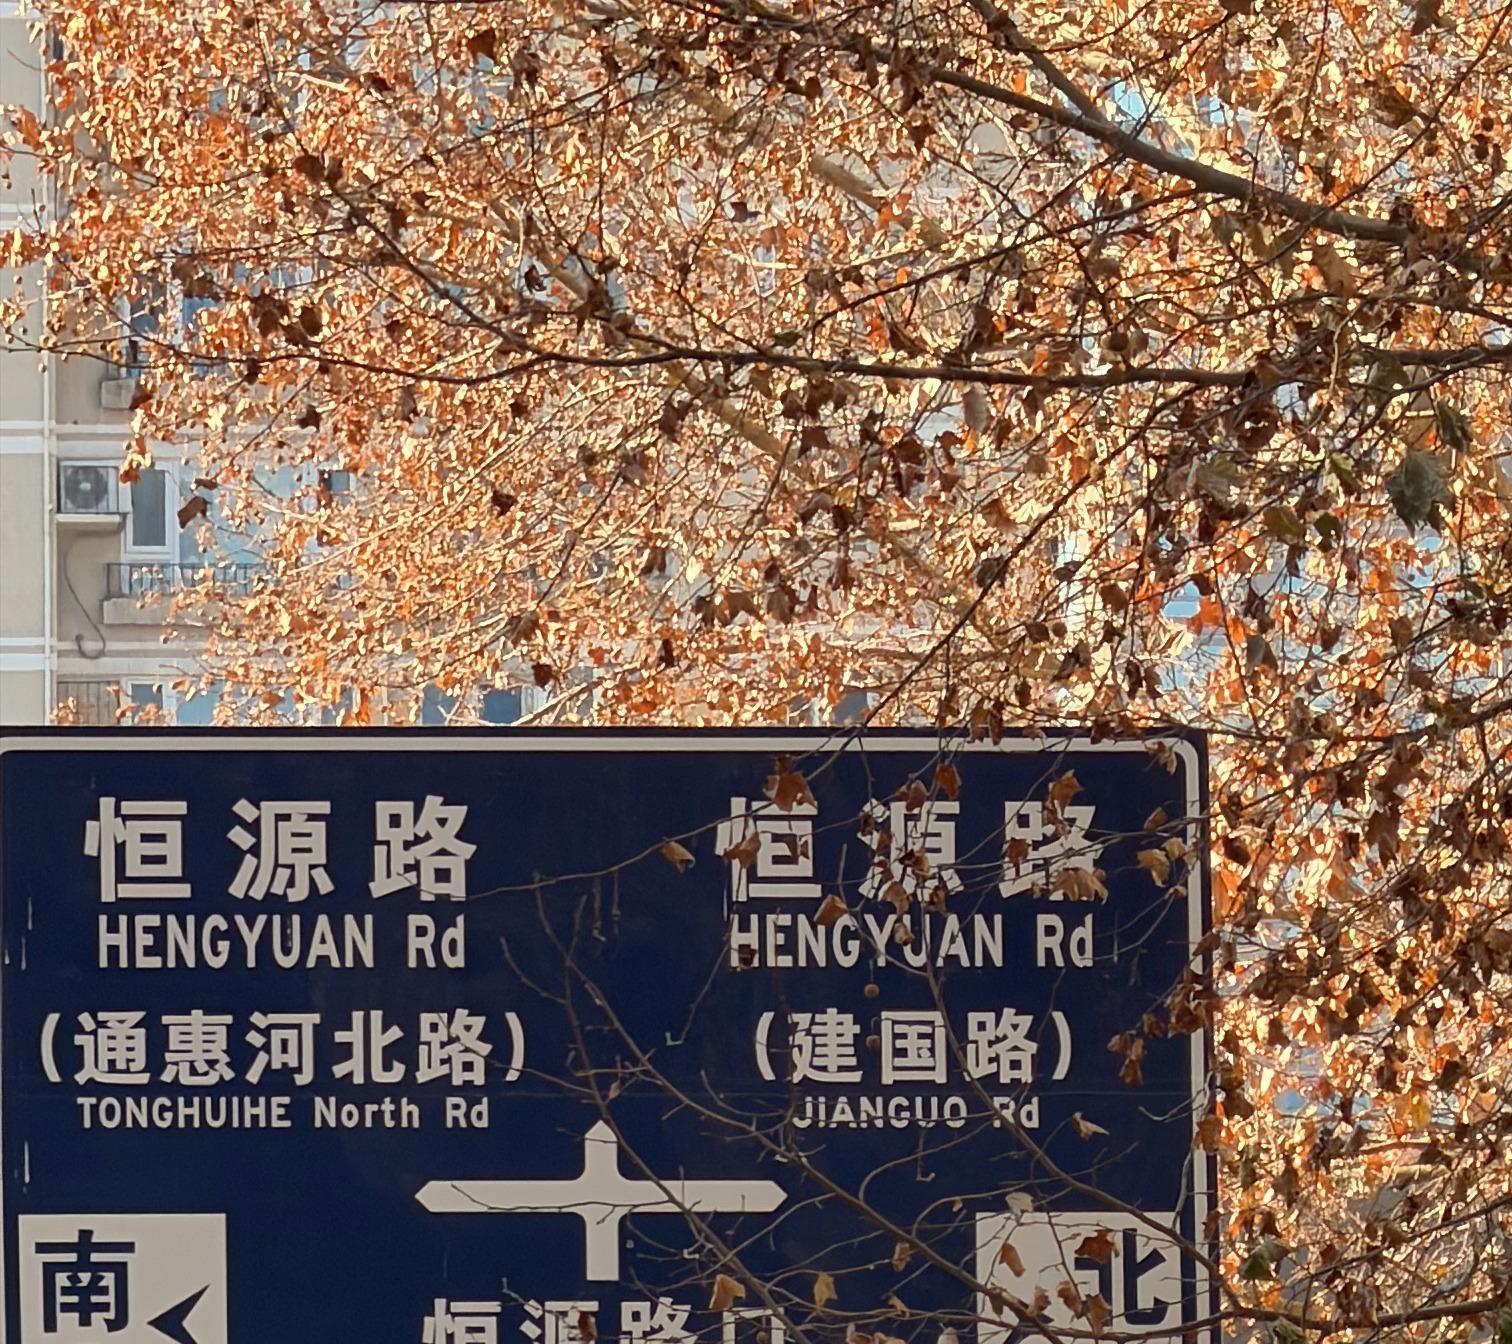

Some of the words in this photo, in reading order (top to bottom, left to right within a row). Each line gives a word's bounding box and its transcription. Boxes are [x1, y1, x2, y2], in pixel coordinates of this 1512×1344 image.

[84, 795, 476, 902] 恒源路
[715, 797, 1108, 902] 恒源路
[99, 914, 375, 969] HENGYUAN
[407, 914, 465, 969] Rd
[729, 914, 1003, 969] HENGYUAN
[1036, 913, 1094, 969] Rd
[40, 1008, 525, 1086] (通惠河北路)
[755, 1007, 1072, 1085] (建国路)
[76, 1096, 292, 1129] TONGHUIHE
[314, 1096, 420, 1129] North
[446, 1096, 489, 1129] Rd
[792, 1096, 968, 1129] JIANGUO
[992, 1096, 1040, 1129] Rd
[35, 1229, 136, 1334] 南
[1074, 1228, 1168, 1326] 北
